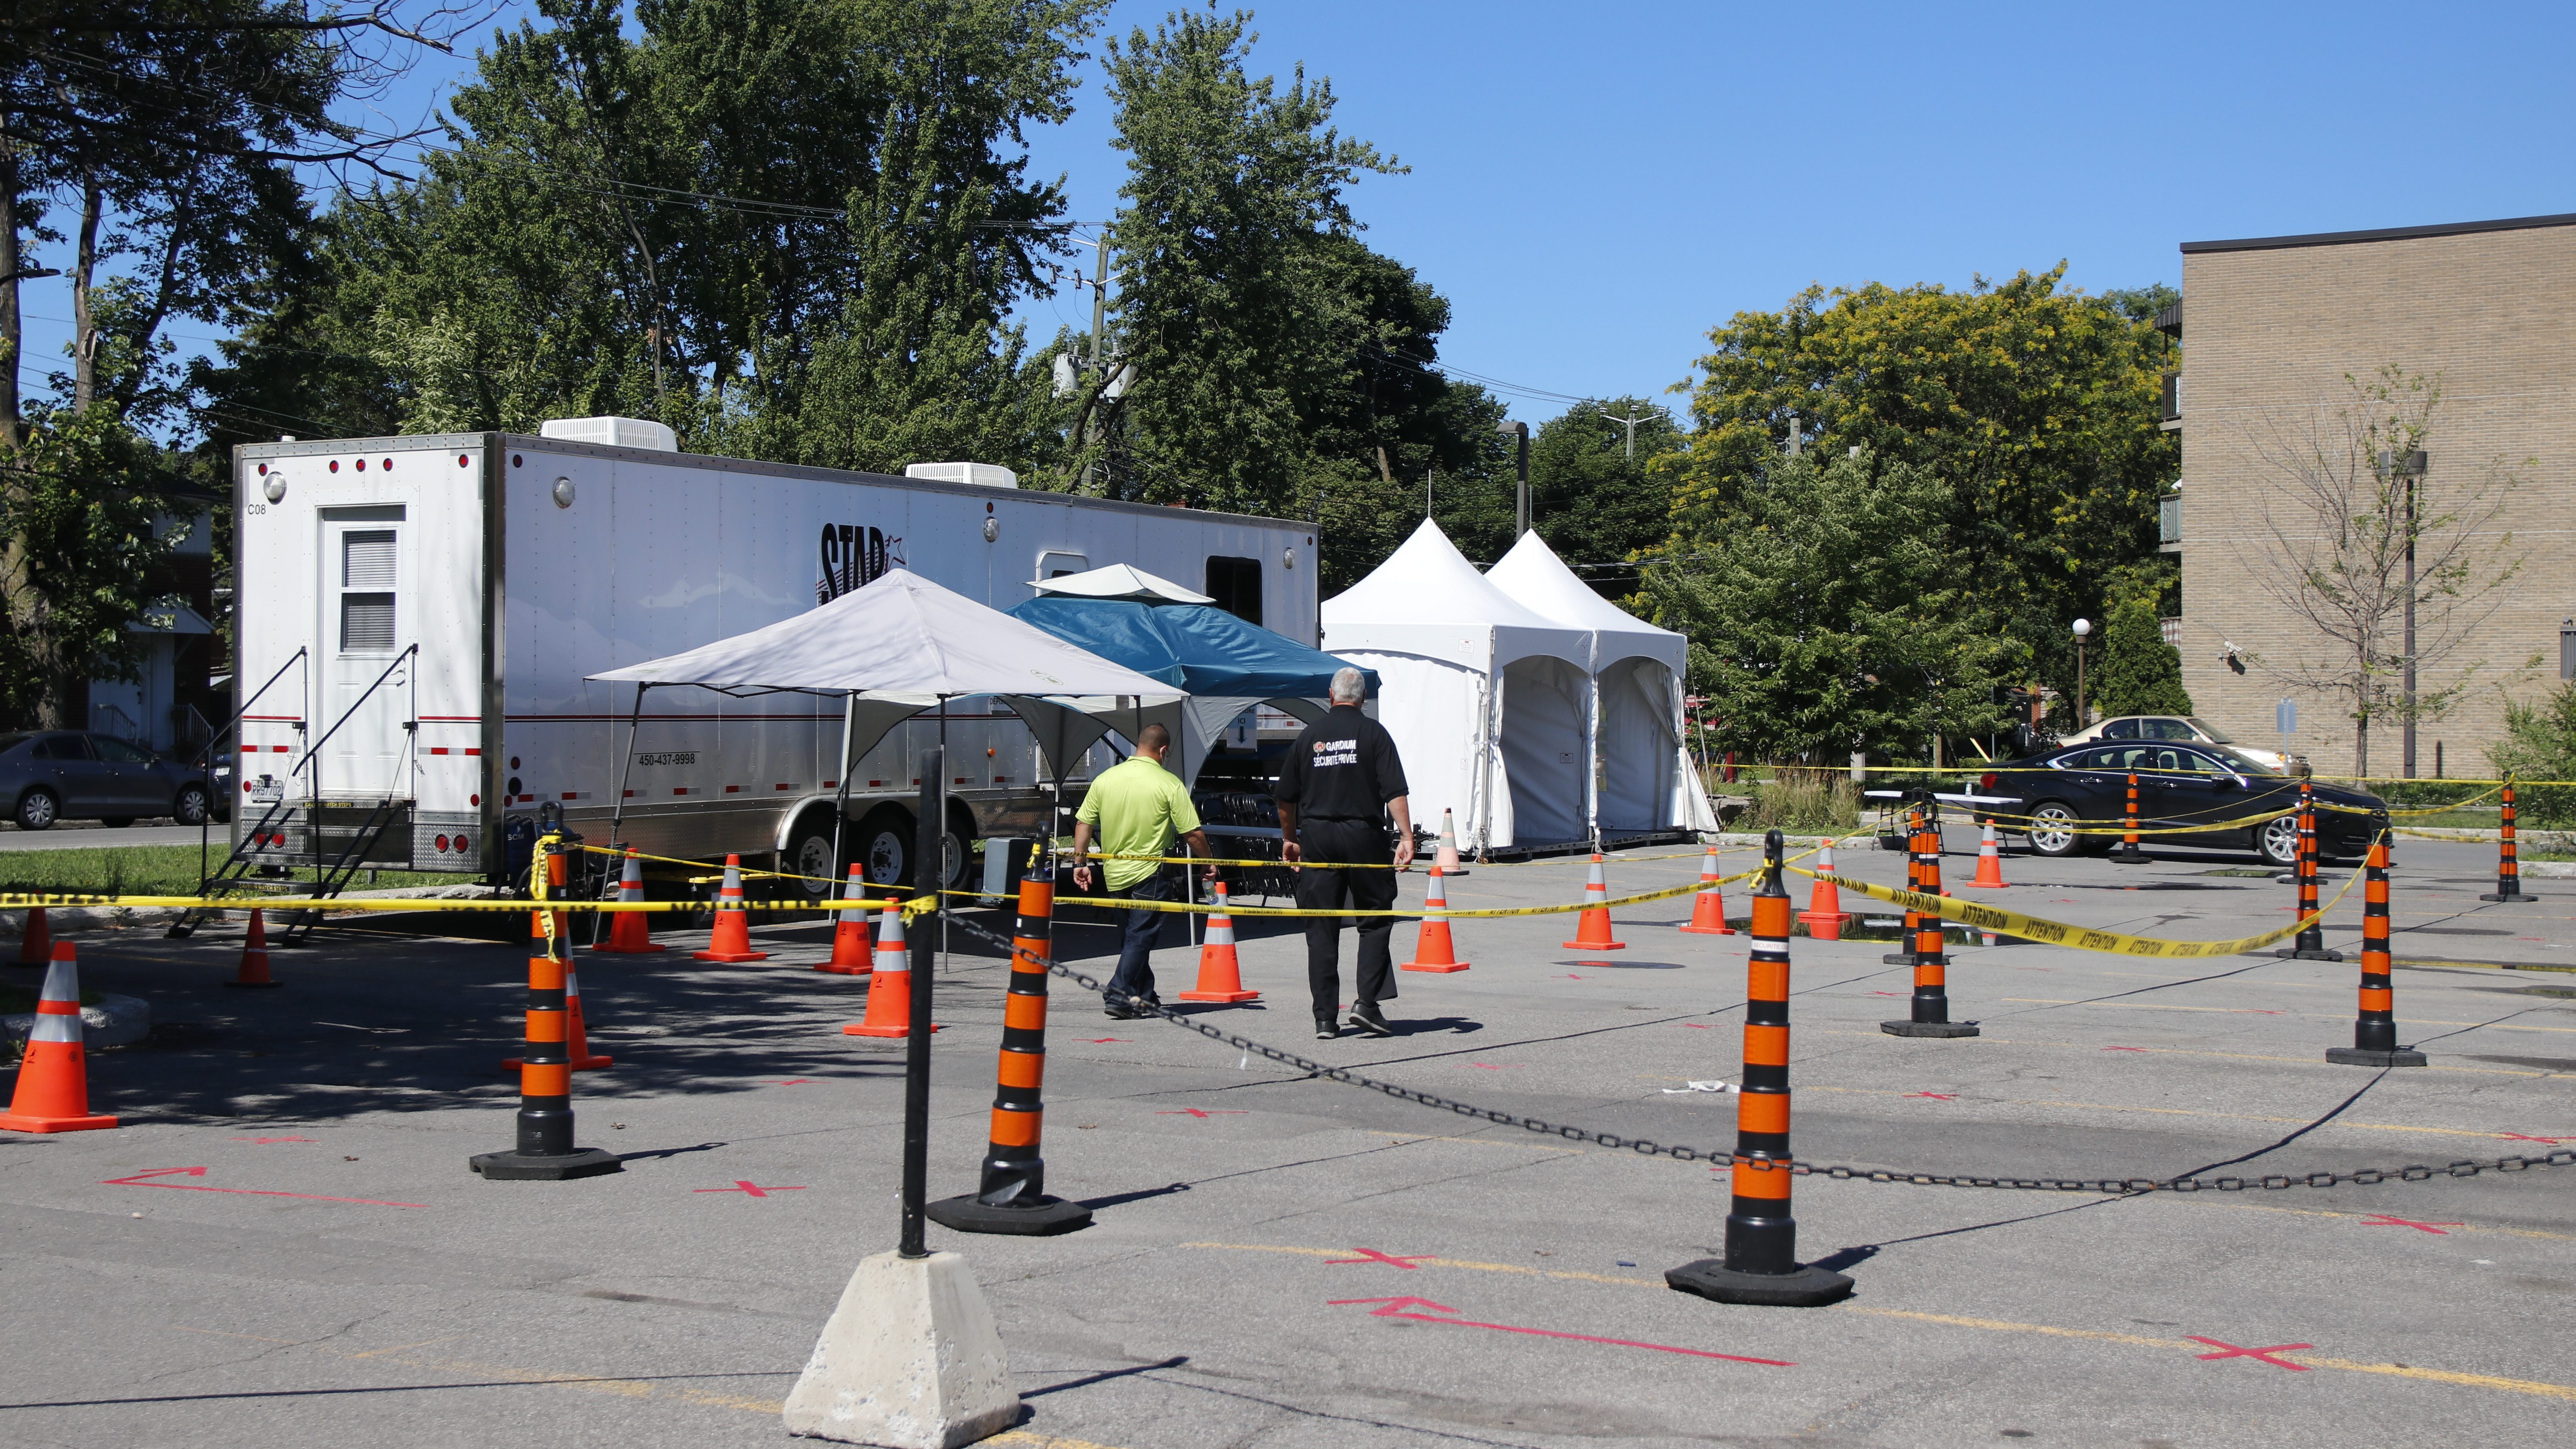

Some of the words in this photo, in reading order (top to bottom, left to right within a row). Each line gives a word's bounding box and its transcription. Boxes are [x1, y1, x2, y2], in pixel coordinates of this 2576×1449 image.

[248, 504, 266, 515] C08
[1326, 739, 1356, 751] GARDIUM
[639, 753, 695, 766] 450-437-9998
[1313, 751, 1338, 767] SÉCURITÉ
[1338, 750, 1357, 764] PRIVÉE
[1889, 887, 1941, 914] ATTENTION
[1959, 904, 2008, 930] ATTENTION
[2022, 920, 2068, 942] ATTENTION
[2077, 931, 2120, 951] ATTENTION
[2126, 939, 2165, 955] ATTENTION
